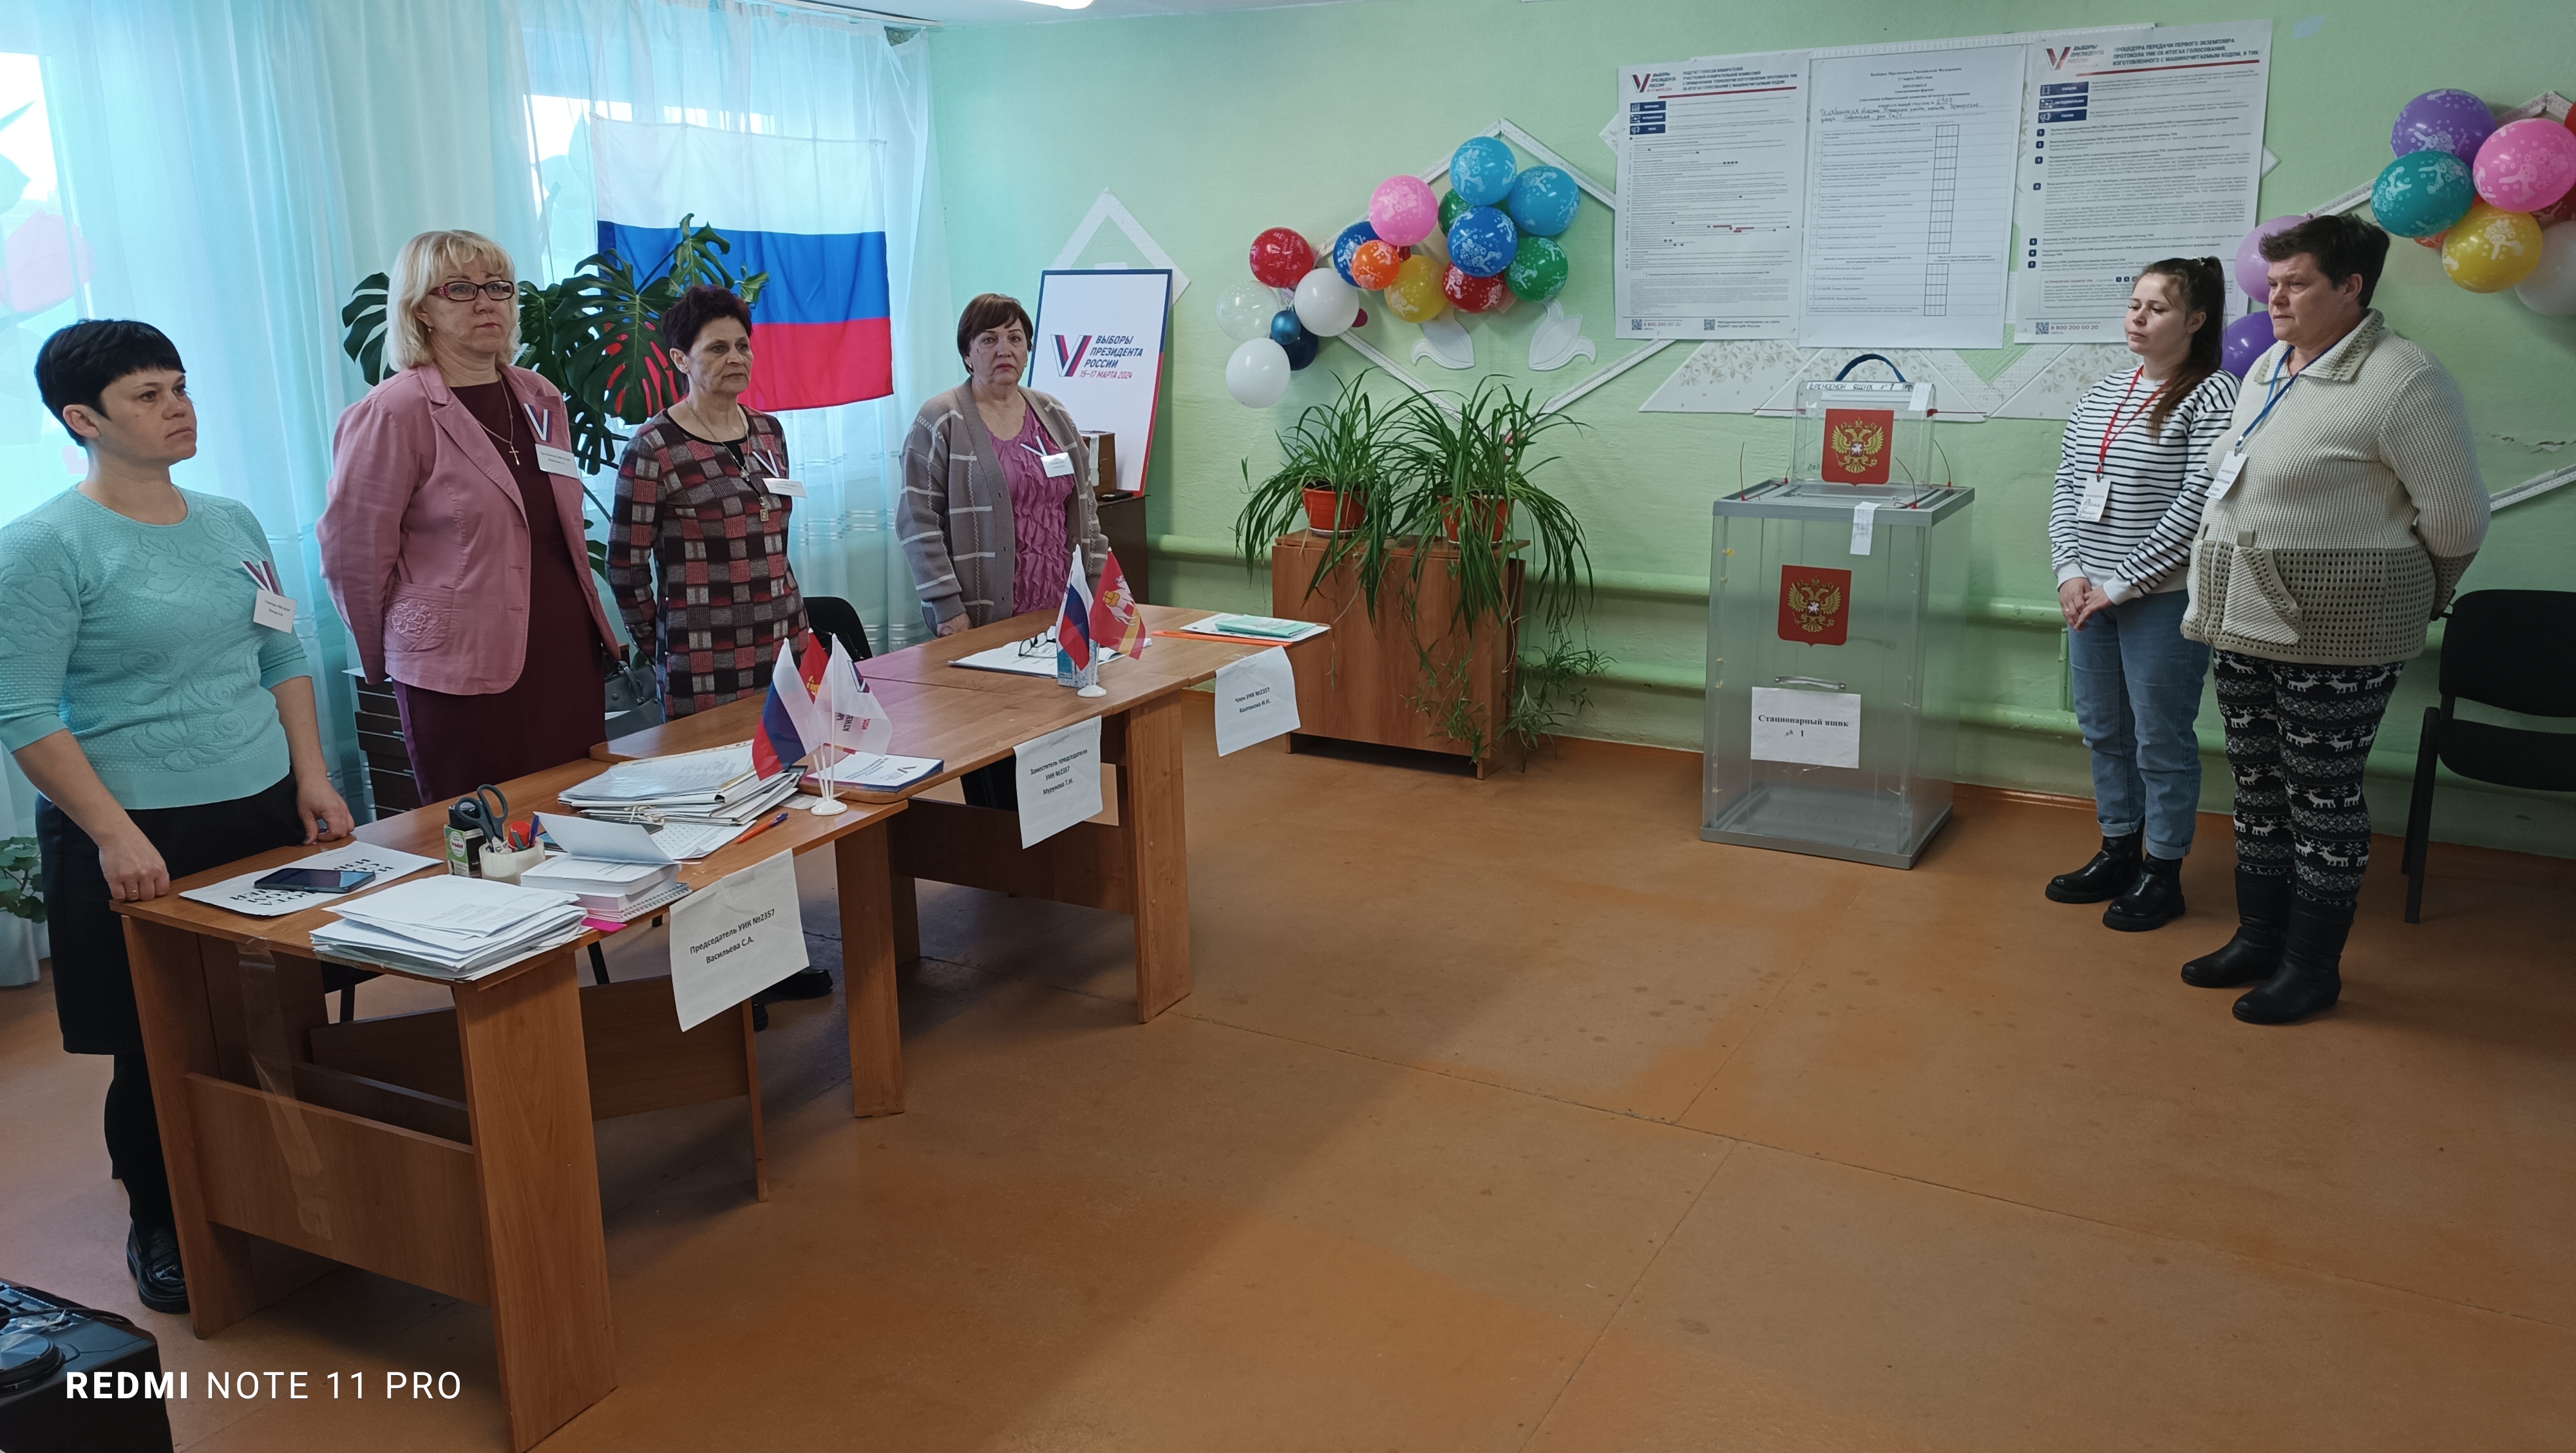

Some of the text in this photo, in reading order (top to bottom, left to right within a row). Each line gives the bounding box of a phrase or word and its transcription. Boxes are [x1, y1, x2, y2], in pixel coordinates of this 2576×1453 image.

[2165, 53, 2221, 62] МАШИНОЧИТАЕМЫМ
[1095, 335, 1134, 345] ВЫБОРЫ
[1090, 347, 1143, 358] ПРЕЗИДЕНТА
[1084, 359, 1119, 368] РОССИИ
[1097, 370, 1117, 379] МАРТА
[1117, 371, 1133, 379] 2024
[1255, 687, 1269, 696] №2357
[1758, 715, 1823, 726] Стационарный
[1030, 749, 1088, 775] Заместитель председателя
[1045, 772, 1055, 781] УИК
[690, 909, 775, 954] Председатель УИК №2357
[706, 936, 754, 964] Васильева С.А.
